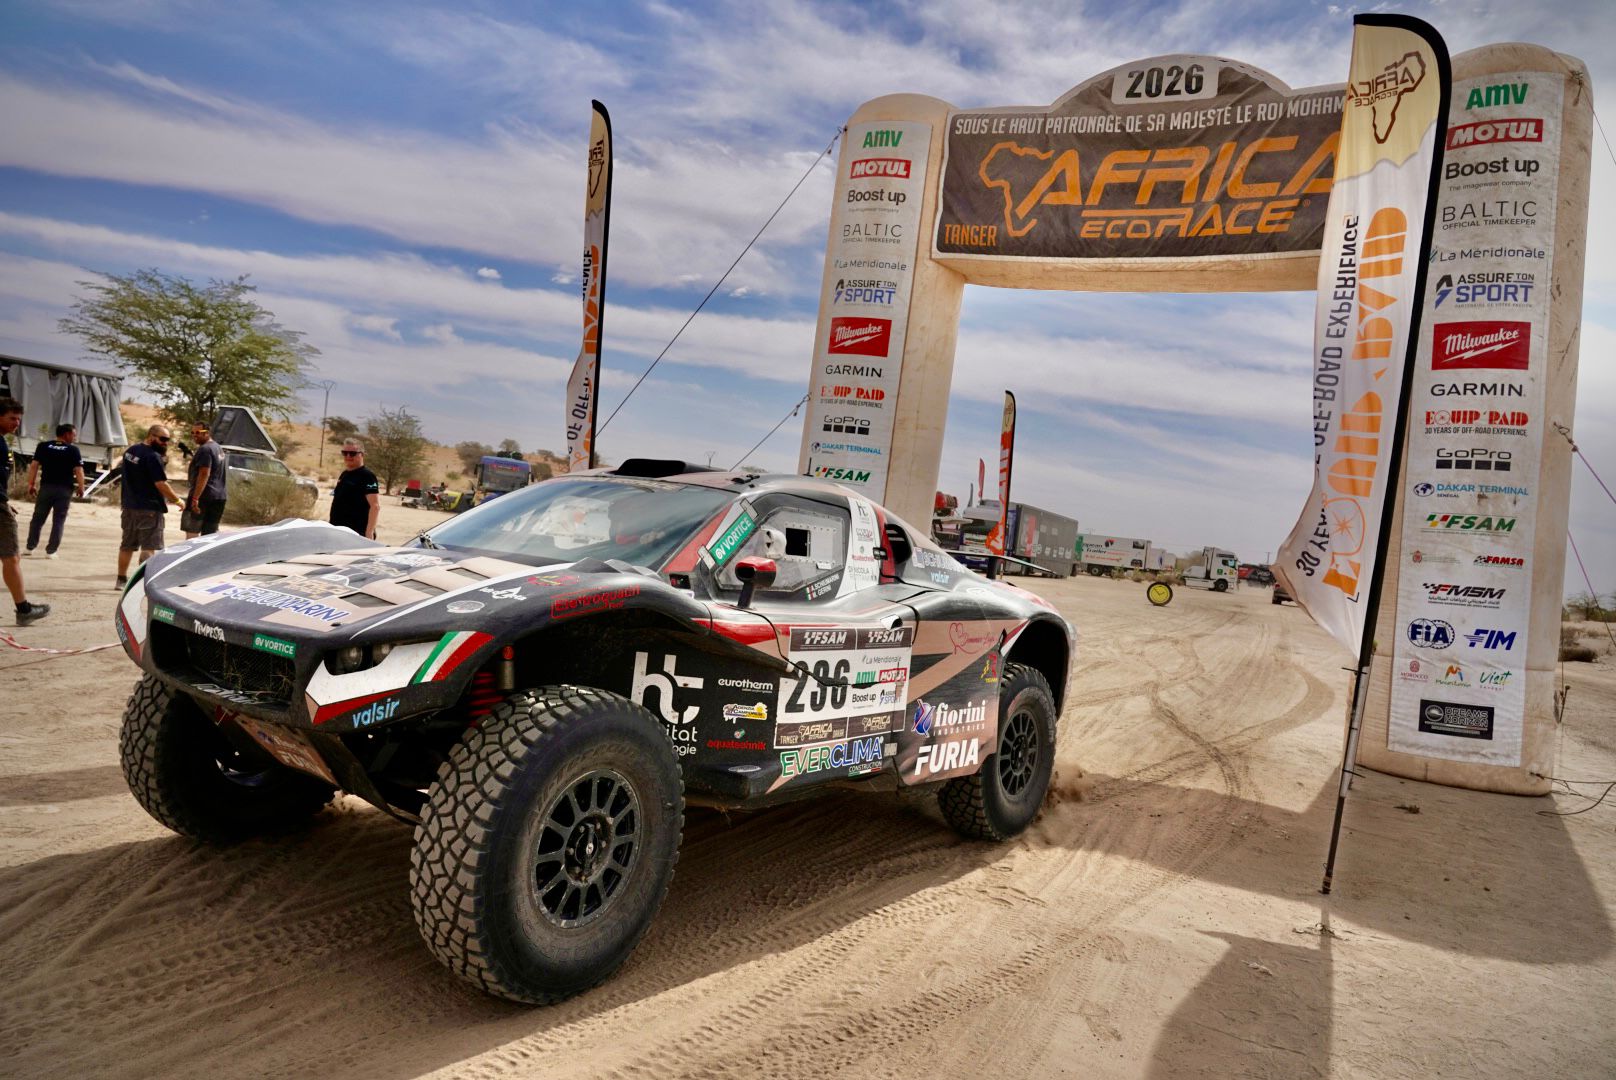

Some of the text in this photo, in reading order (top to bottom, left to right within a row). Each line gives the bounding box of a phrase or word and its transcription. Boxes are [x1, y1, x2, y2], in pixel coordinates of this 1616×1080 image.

[1125, 64, 1204, 98] 2026
[1465, 83, 1528, 110] AMV
[955, 118, 989, 134] SOUS
[992, 118, 1006, 134] LE
[1009, 118, 1044, 134] HAUT
[1045, 115, 1122, 134] PATRONAGE
[1125, 114, 1142, 133] DE
[1147, 113, 1165, 132] SA
[1236, 104, 1252, 123] LE
[1257, 102, 1283, 121] ROI
[1286, 95, 1345, 118] MOHAM
[862, 130, 903, 148] AMV
[1450, 121, 1539, 147] MOTUL
[851, 160, 910, 178] MOTUL
[1015, 131, 1340, 220] AFRICA
[1445, 157, 1540, 180] Boost up
[1463, 180, 1500, 190] imagewear
[847, 189, 906, 206] Boost up
[1080, 199, 1300, 238] ECORACE
[1442, 201, 1537, 222] BALTIC
[843, 223, 903, 238] BALTIC
[1442, 218, 1536, 230] OFFICIAL TIMEKEEPER
[945, 223, 997, 246] TANGER
[1440, 251, 1456, 261] La
[839, 259, 848, 269] La
[846, 280, 881, 288] ASSURE
[1457, 273, 1514, 284] ASSURE
[844, 288, 895, 304] SPORT
[1456, 284, 1534, 303] SPORT
[835, 323, 883, 342] Milwaukee
[1441, 328, 1519, 355] Milwaukee
[825, 365, 882, 378] GARMIN
[1431, 383, 1523, 396] GARMIN
[824, 415, 870, 426] GoPro
[1492, 427, 1527, 437] EXPERIENCE
[846, 444, 882, 455] TERMINAL
[1436, 448, 1512, 460] GoPro
[824, 467, 870, 482] FSAM
[1437, 483, 1528, 496] DAKAR TERMINAL
[1445, 515, 1516, 532] FSAM
[723, 517, 752, 549] VORTICE
[1434, 584, 1506, 599] FMSM
[194, 619, 226, 642] TEMPESTA
[813, 631, 847, 644] FSAM
[876, 630, 904, 643] FSAM
[264, 639, 294, 654] VORTICE
[1469, 629, 1517, 650] FIM
[718, 678, 773, 690] eurotherm
[855, 671, 877, 684] AMV
[1479, 670, 1512, 685] Visit
[785, 658, 850, 713] 296
[852, 693, 868, 702] Boost
[869, 693, 876, 702] up
[352, 697, 400, 728] valsir
[934, 700, 986, 728] fiorini
[1445, 706, 1489, 719] DREAMS
[867, 715, 891, 727] AFRICA
[1444, 715, 1489, 728] HORIZON
[666, 724, 698, 742] itat
[780, 735, 798, 744] TANGER
[804, 723, 833, 736] AFRICA
[933, 723, 986, 737] INDUSTRIES
[707, 739, 767, 751] aquatechnik
[780, 737, 883, 777] EVERCLIMA
[914, 738, 979, 776] FURIA
[848, 761, 883, 773] CONSTRUCTION
